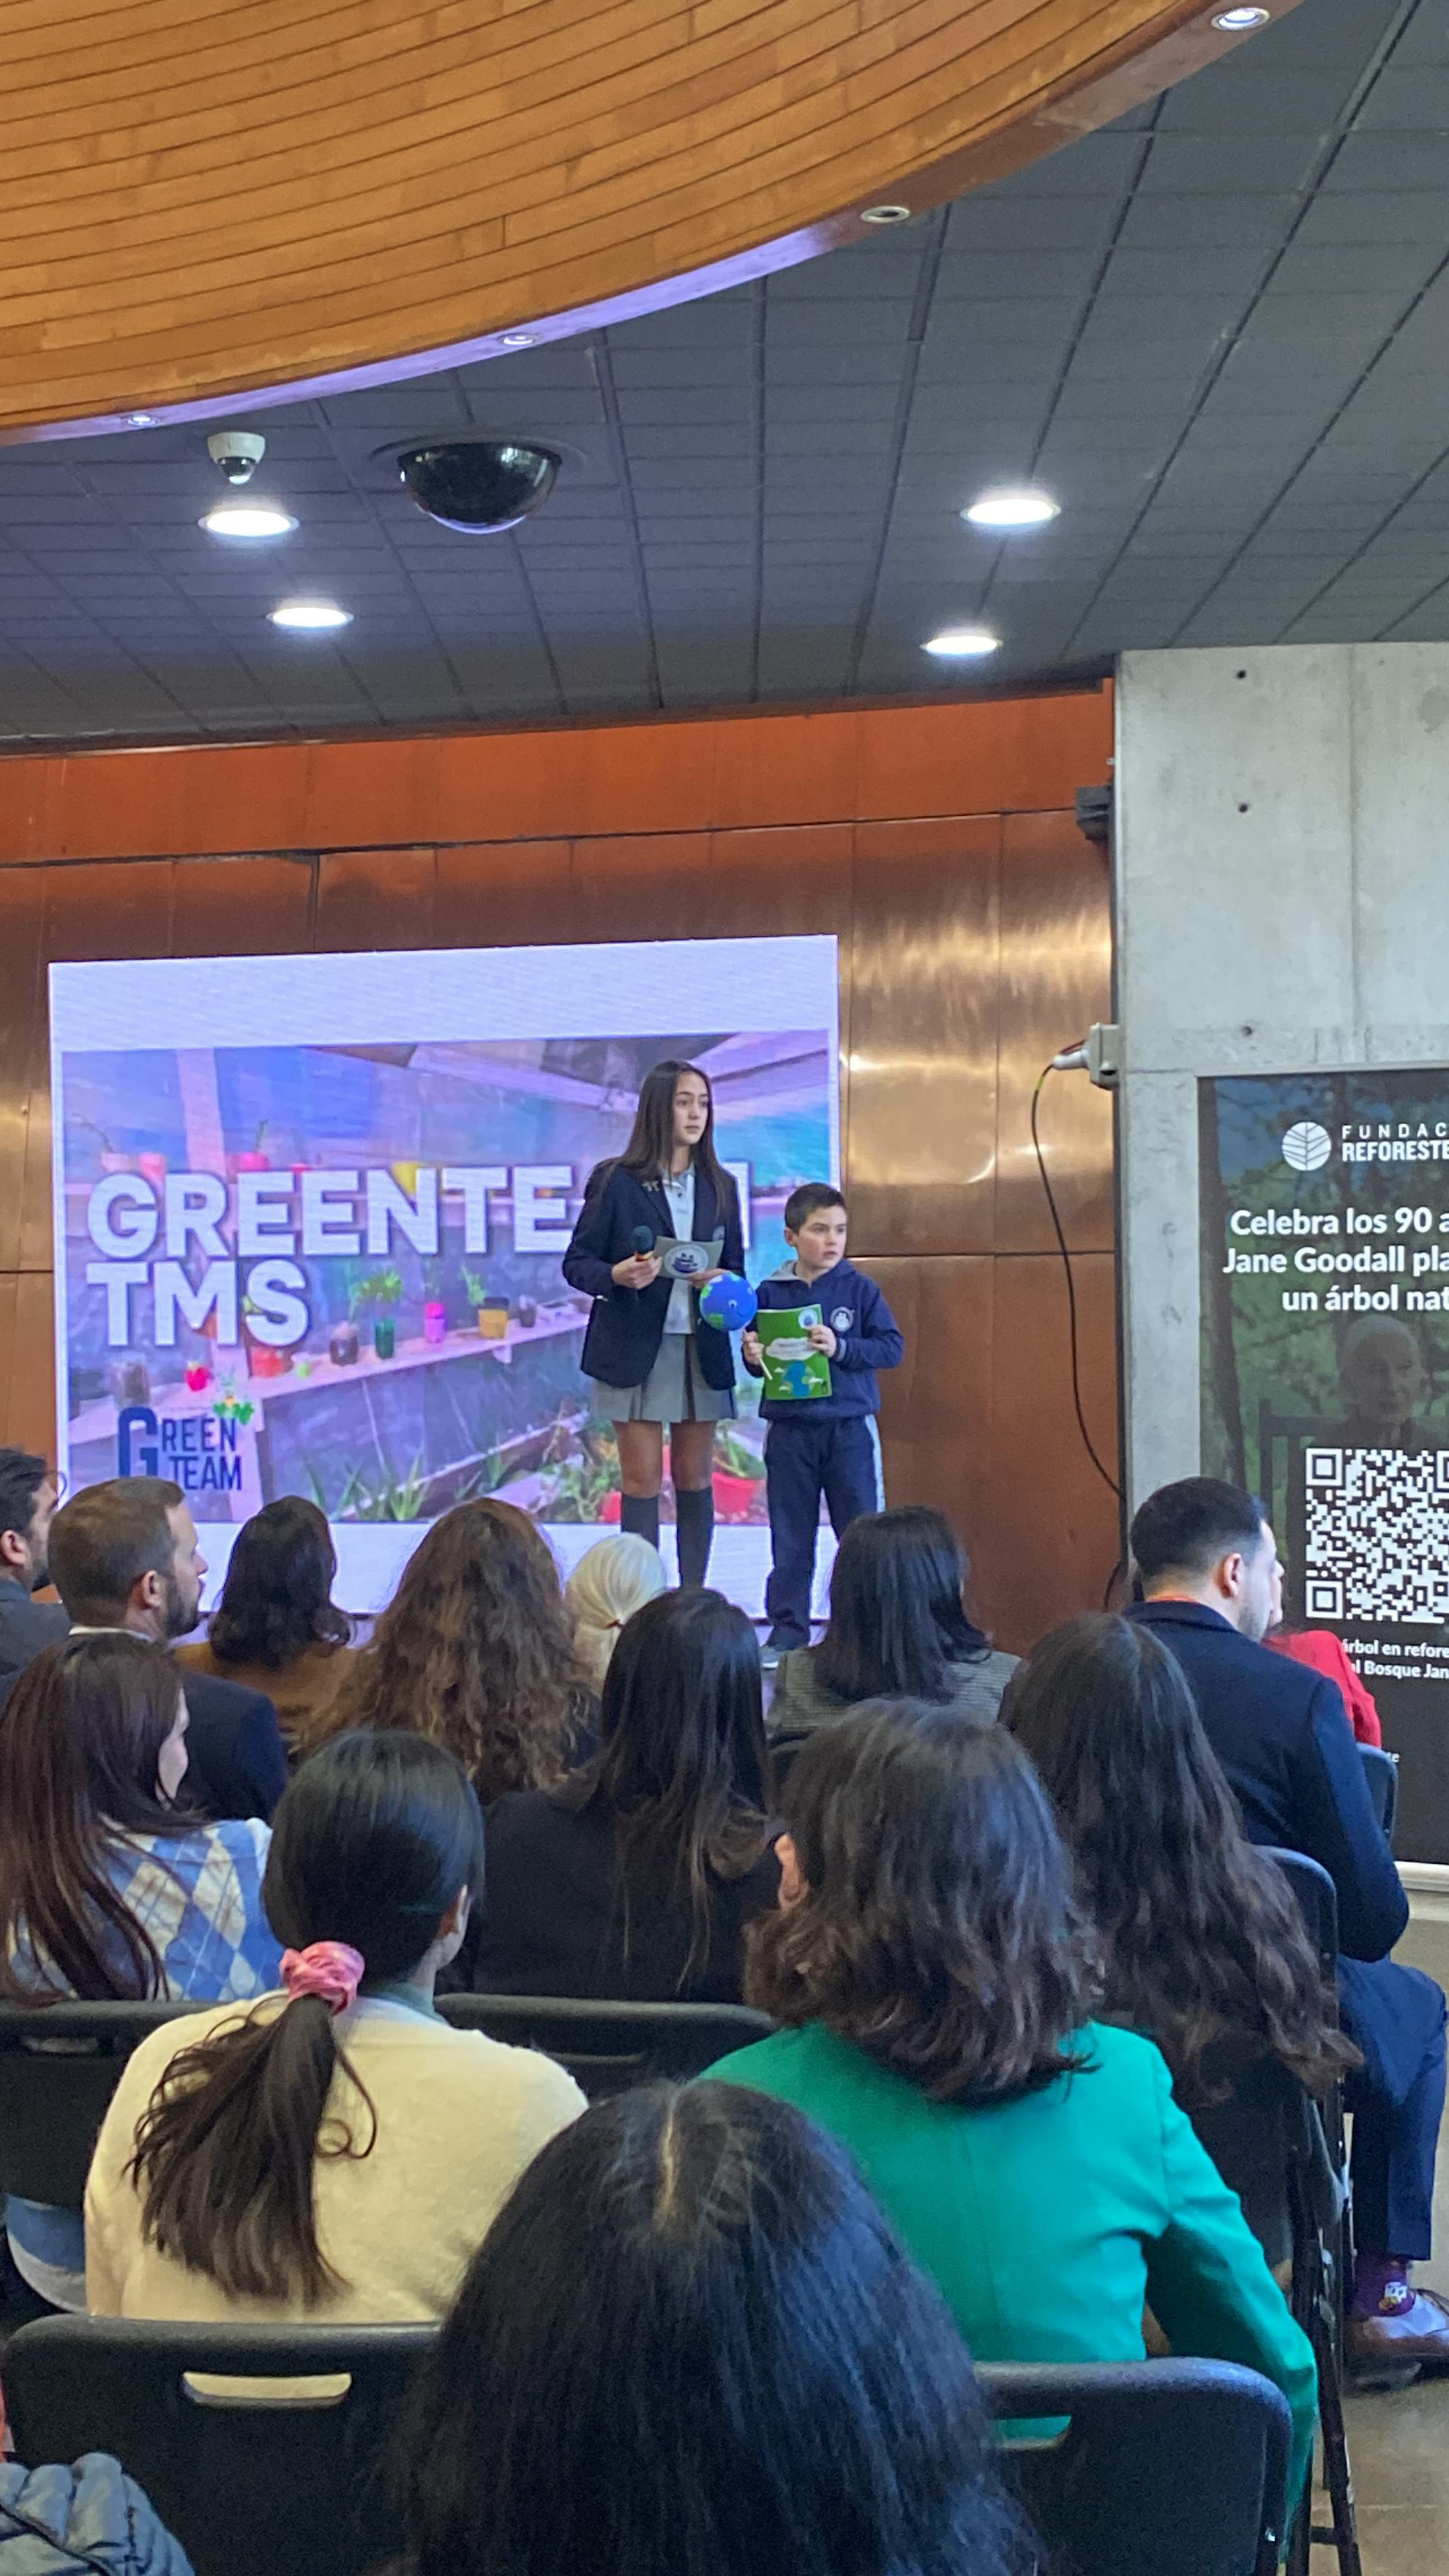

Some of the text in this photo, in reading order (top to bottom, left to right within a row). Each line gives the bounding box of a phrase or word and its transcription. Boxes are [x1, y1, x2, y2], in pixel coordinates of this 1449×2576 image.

[1341, 1122, 1448, 1139] FUNDAC
[1341, 1139, 1449, 1162] REFORESTE
[87, 1161, 751, 1260] GREENTE
[1230, 1208, 1339, 1235] Celebra
[1347, 1208, 1388, 1234] los
[1395, 1207, 1432, 1233] 90
[1222, 1245, 1449, 1277] Jane Goodall pla
[86, 1258, 310, 1347] TMS
[1282, 1284, 1449, 1311] un árbol nat
[119, 1407, 236, 1478] GREEN
[168, 1456, 242, 1490] TEAM
[1382, 1644, 1401, 1655] en
[1404, 1641, 1449, 1658] refore
[1364, 1660, 1421, 1679] Bosque
[1423, 1663, 1449, 1679] Jan
